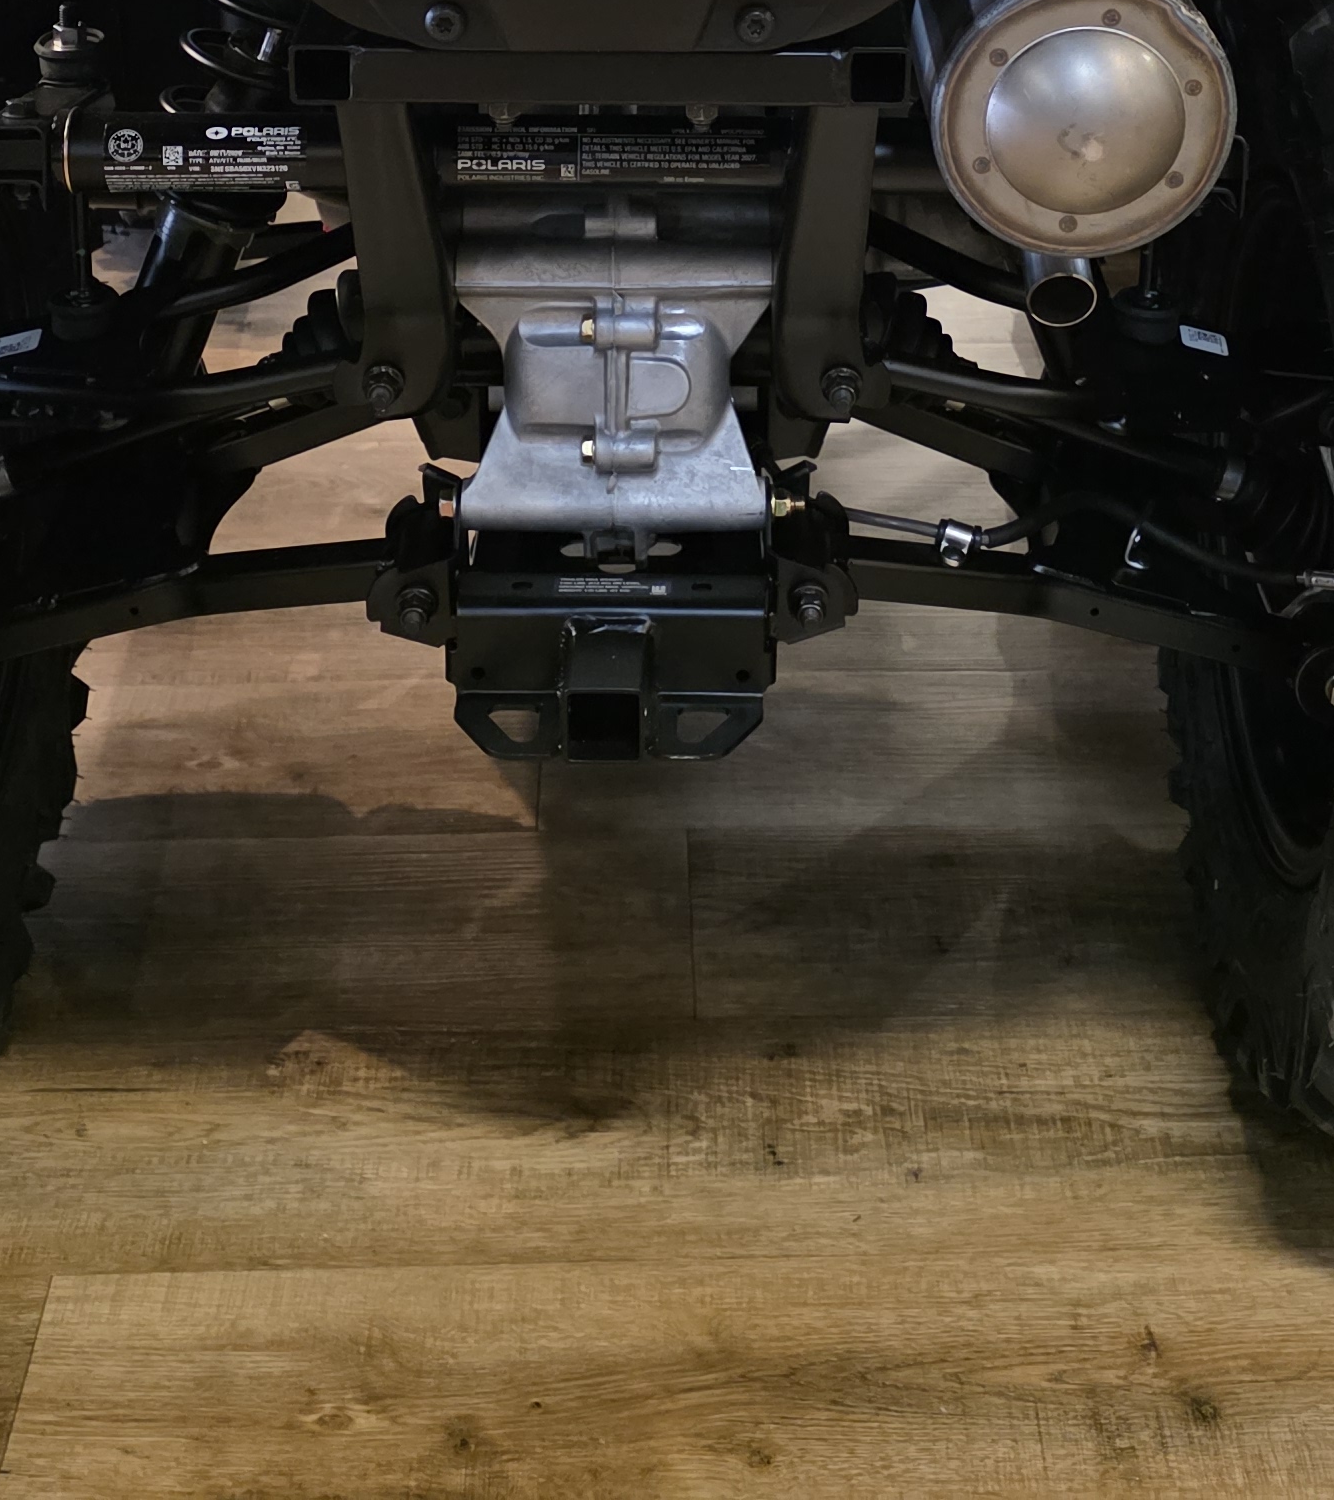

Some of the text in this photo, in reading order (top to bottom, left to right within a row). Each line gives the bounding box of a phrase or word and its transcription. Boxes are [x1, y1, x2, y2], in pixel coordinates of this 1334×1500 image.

[231, 127, 301, 138] POLARIS
[609, 144, 623, 152] THIS
[457, 159, 546, 170] POLARIS
[582, 160, 595, 168] THIS
[597, 160, 621, 168] VEHICLE
